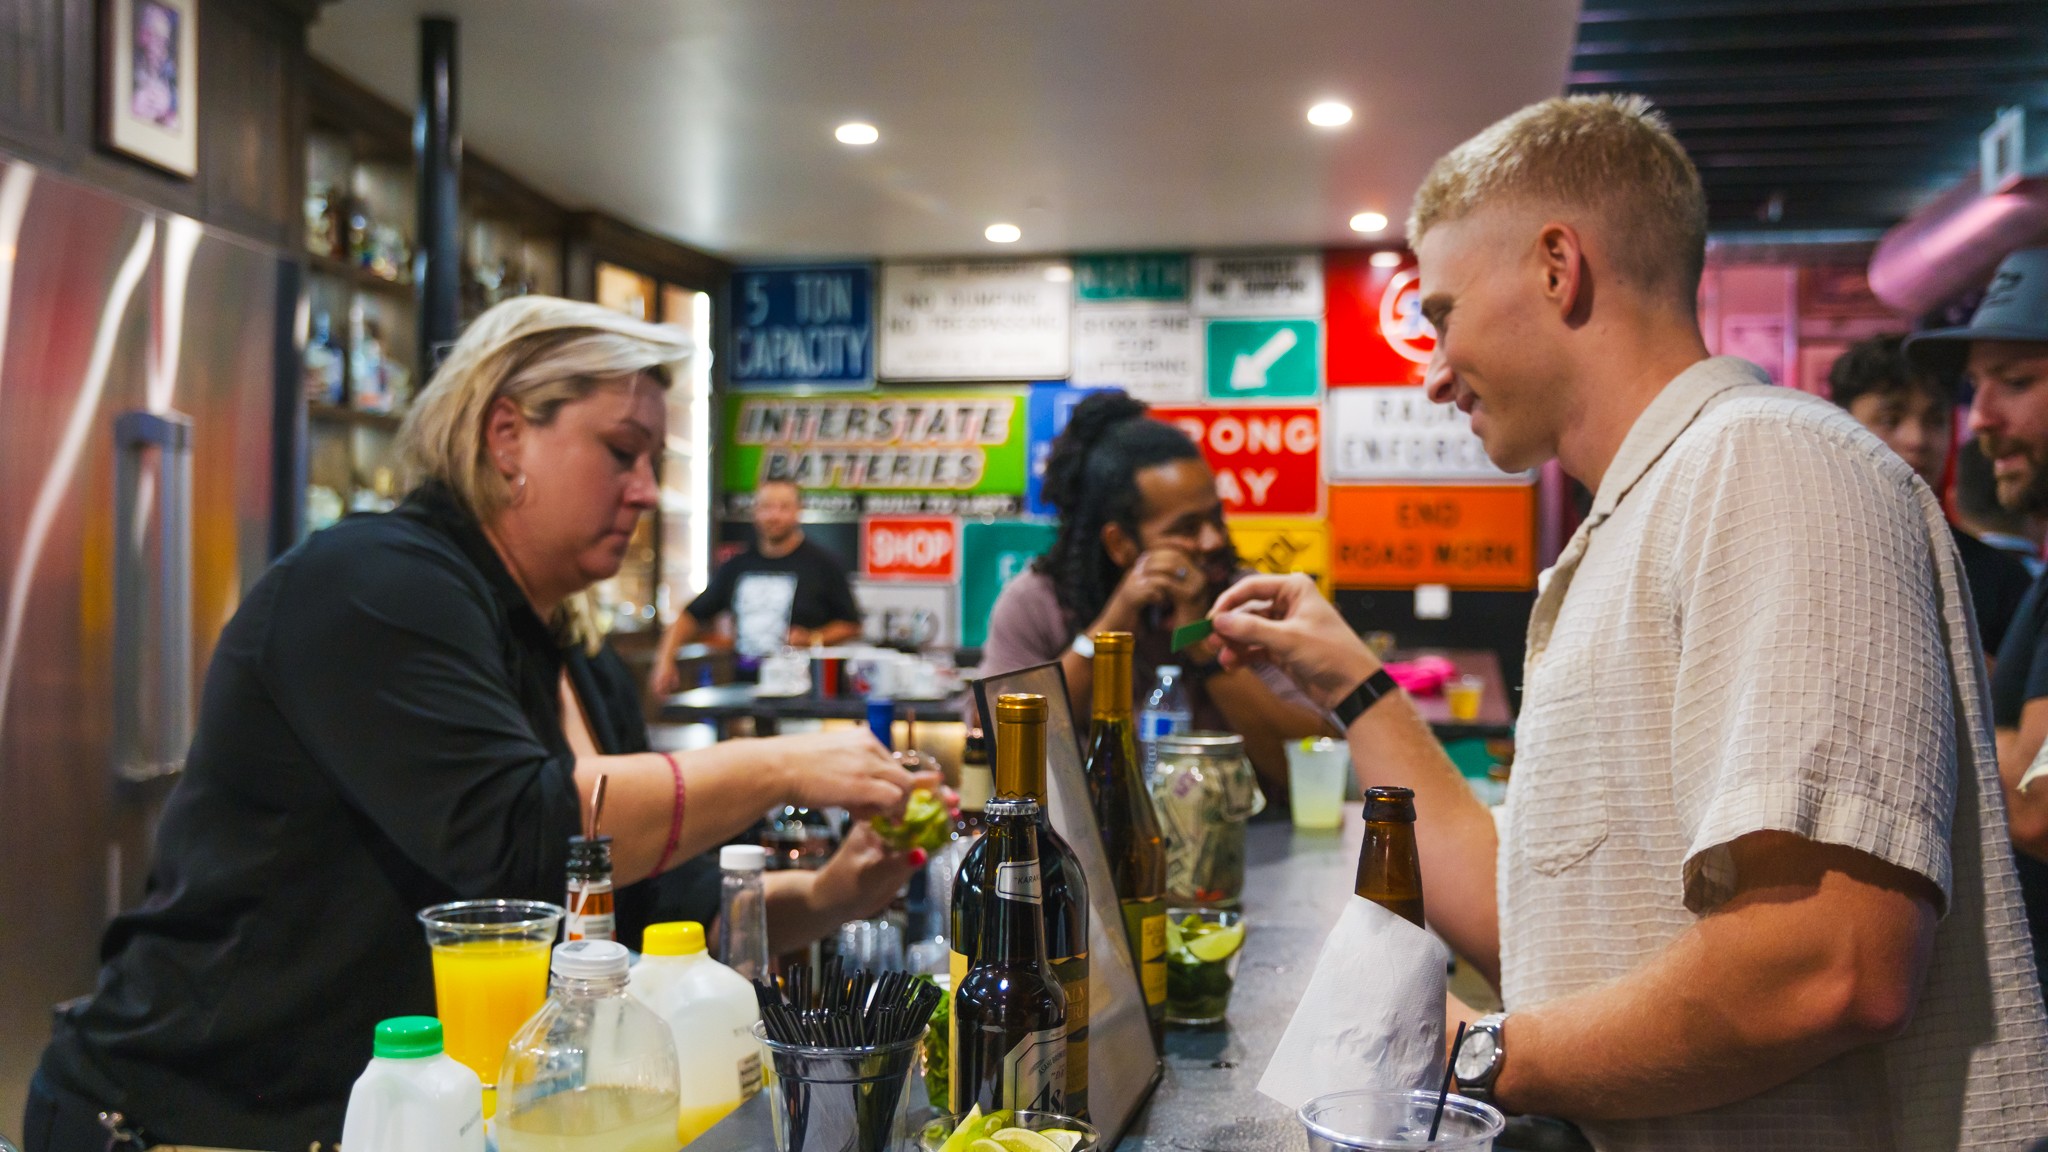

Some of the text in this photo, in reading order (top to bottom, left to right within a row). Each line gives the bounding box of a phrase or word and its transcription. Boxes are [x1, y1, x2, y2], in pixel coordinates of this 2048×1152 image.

[745, 272, 852, 326] 5 TON
[906, 293, 934, 311] NO
[887, 316, 916, 335] NO
[736, 326, 868, 378] CAPACITY
[1115, 338, 1157, 353] FOR
[739, 402, 1011, 440] INTERSTATE
[1374, 397, 1461, 423] RADA
[1342, 435, 1492, 465] ENFORC
[764, 450, 985, 486] BATTERIES
[1216, 467, 1279, 506] AY
[1397, 501, 1459, 527] END
[872, 527, 950, 569] SHOP
[1338, 542, 1517, 568] ROAD WORK
